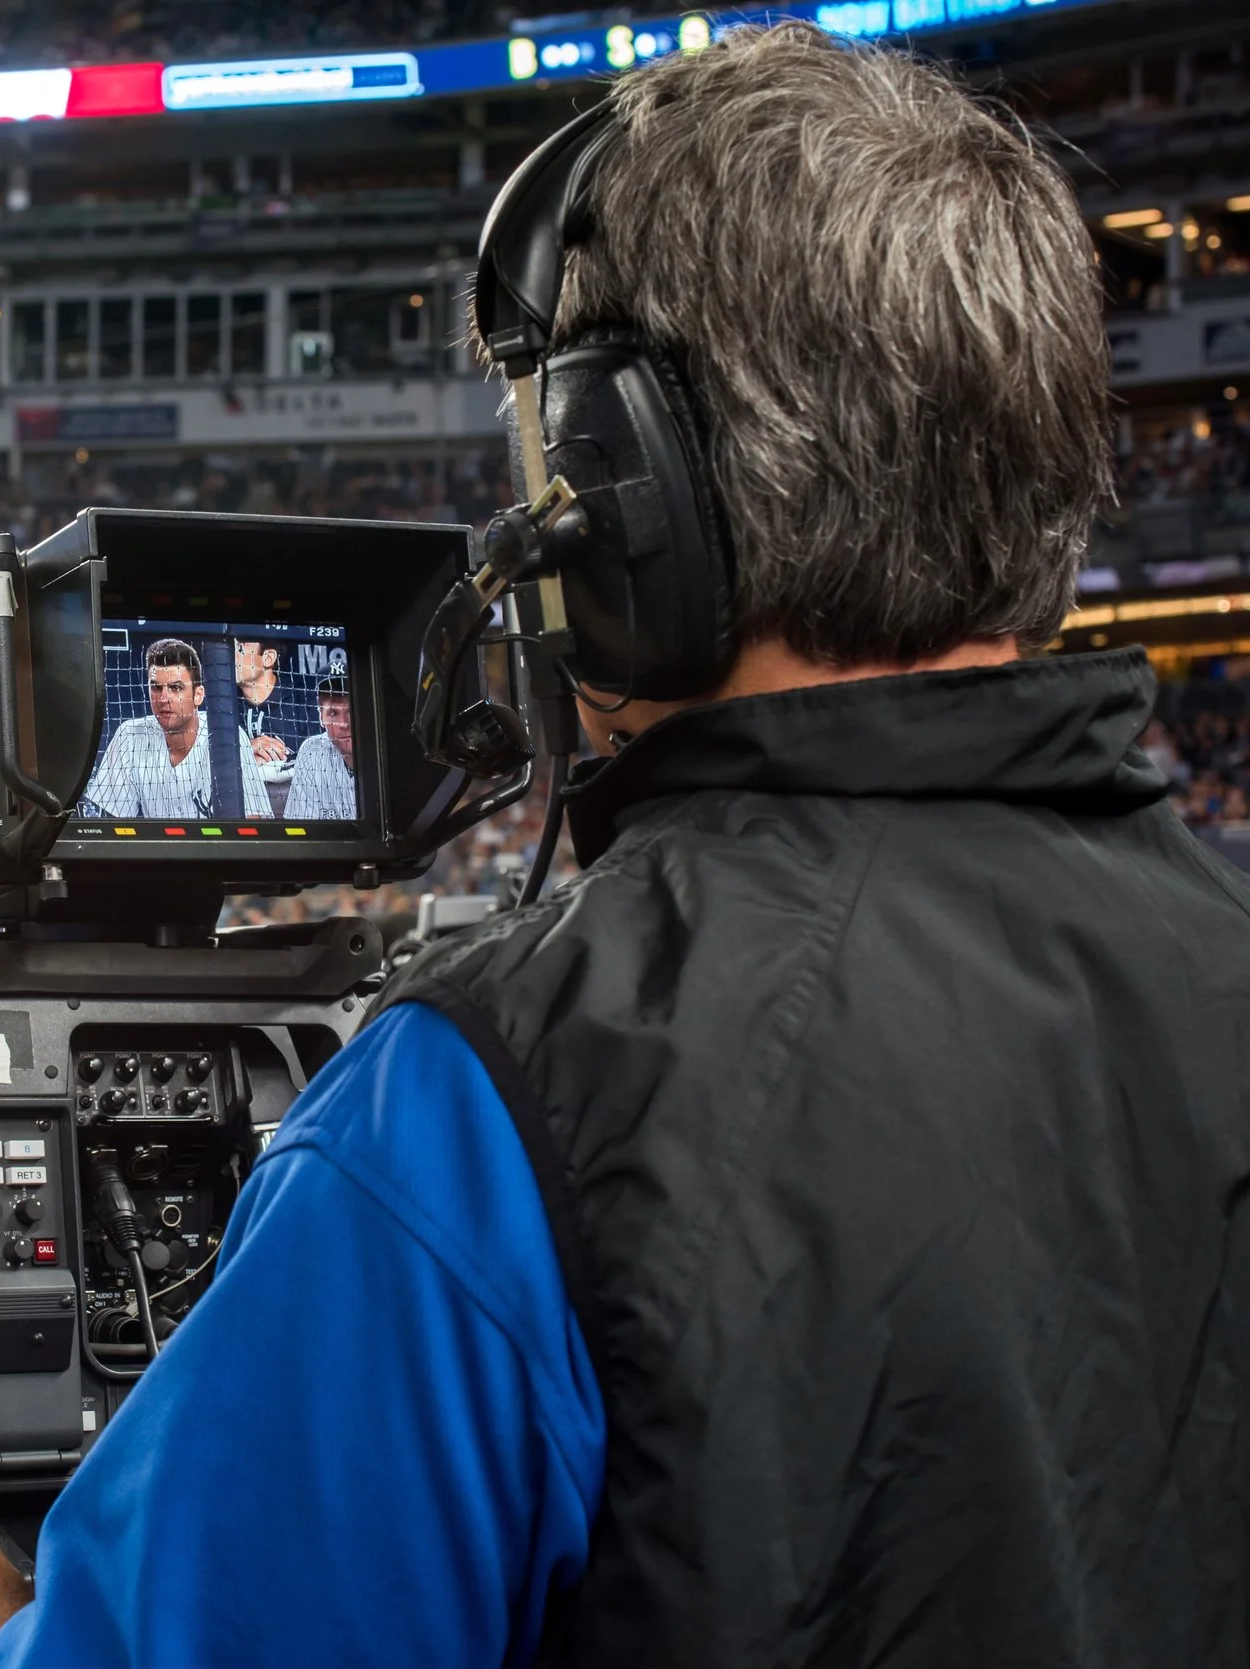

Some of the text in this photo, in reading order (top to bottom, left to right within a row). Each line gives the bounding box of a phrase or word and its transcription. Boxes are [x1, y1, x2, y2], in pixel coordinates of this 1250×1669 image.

[310, 627, 340, 637] F239
[24, 1144, 30, 1153] B
[17, 1171, 41, 1179] RET 3
